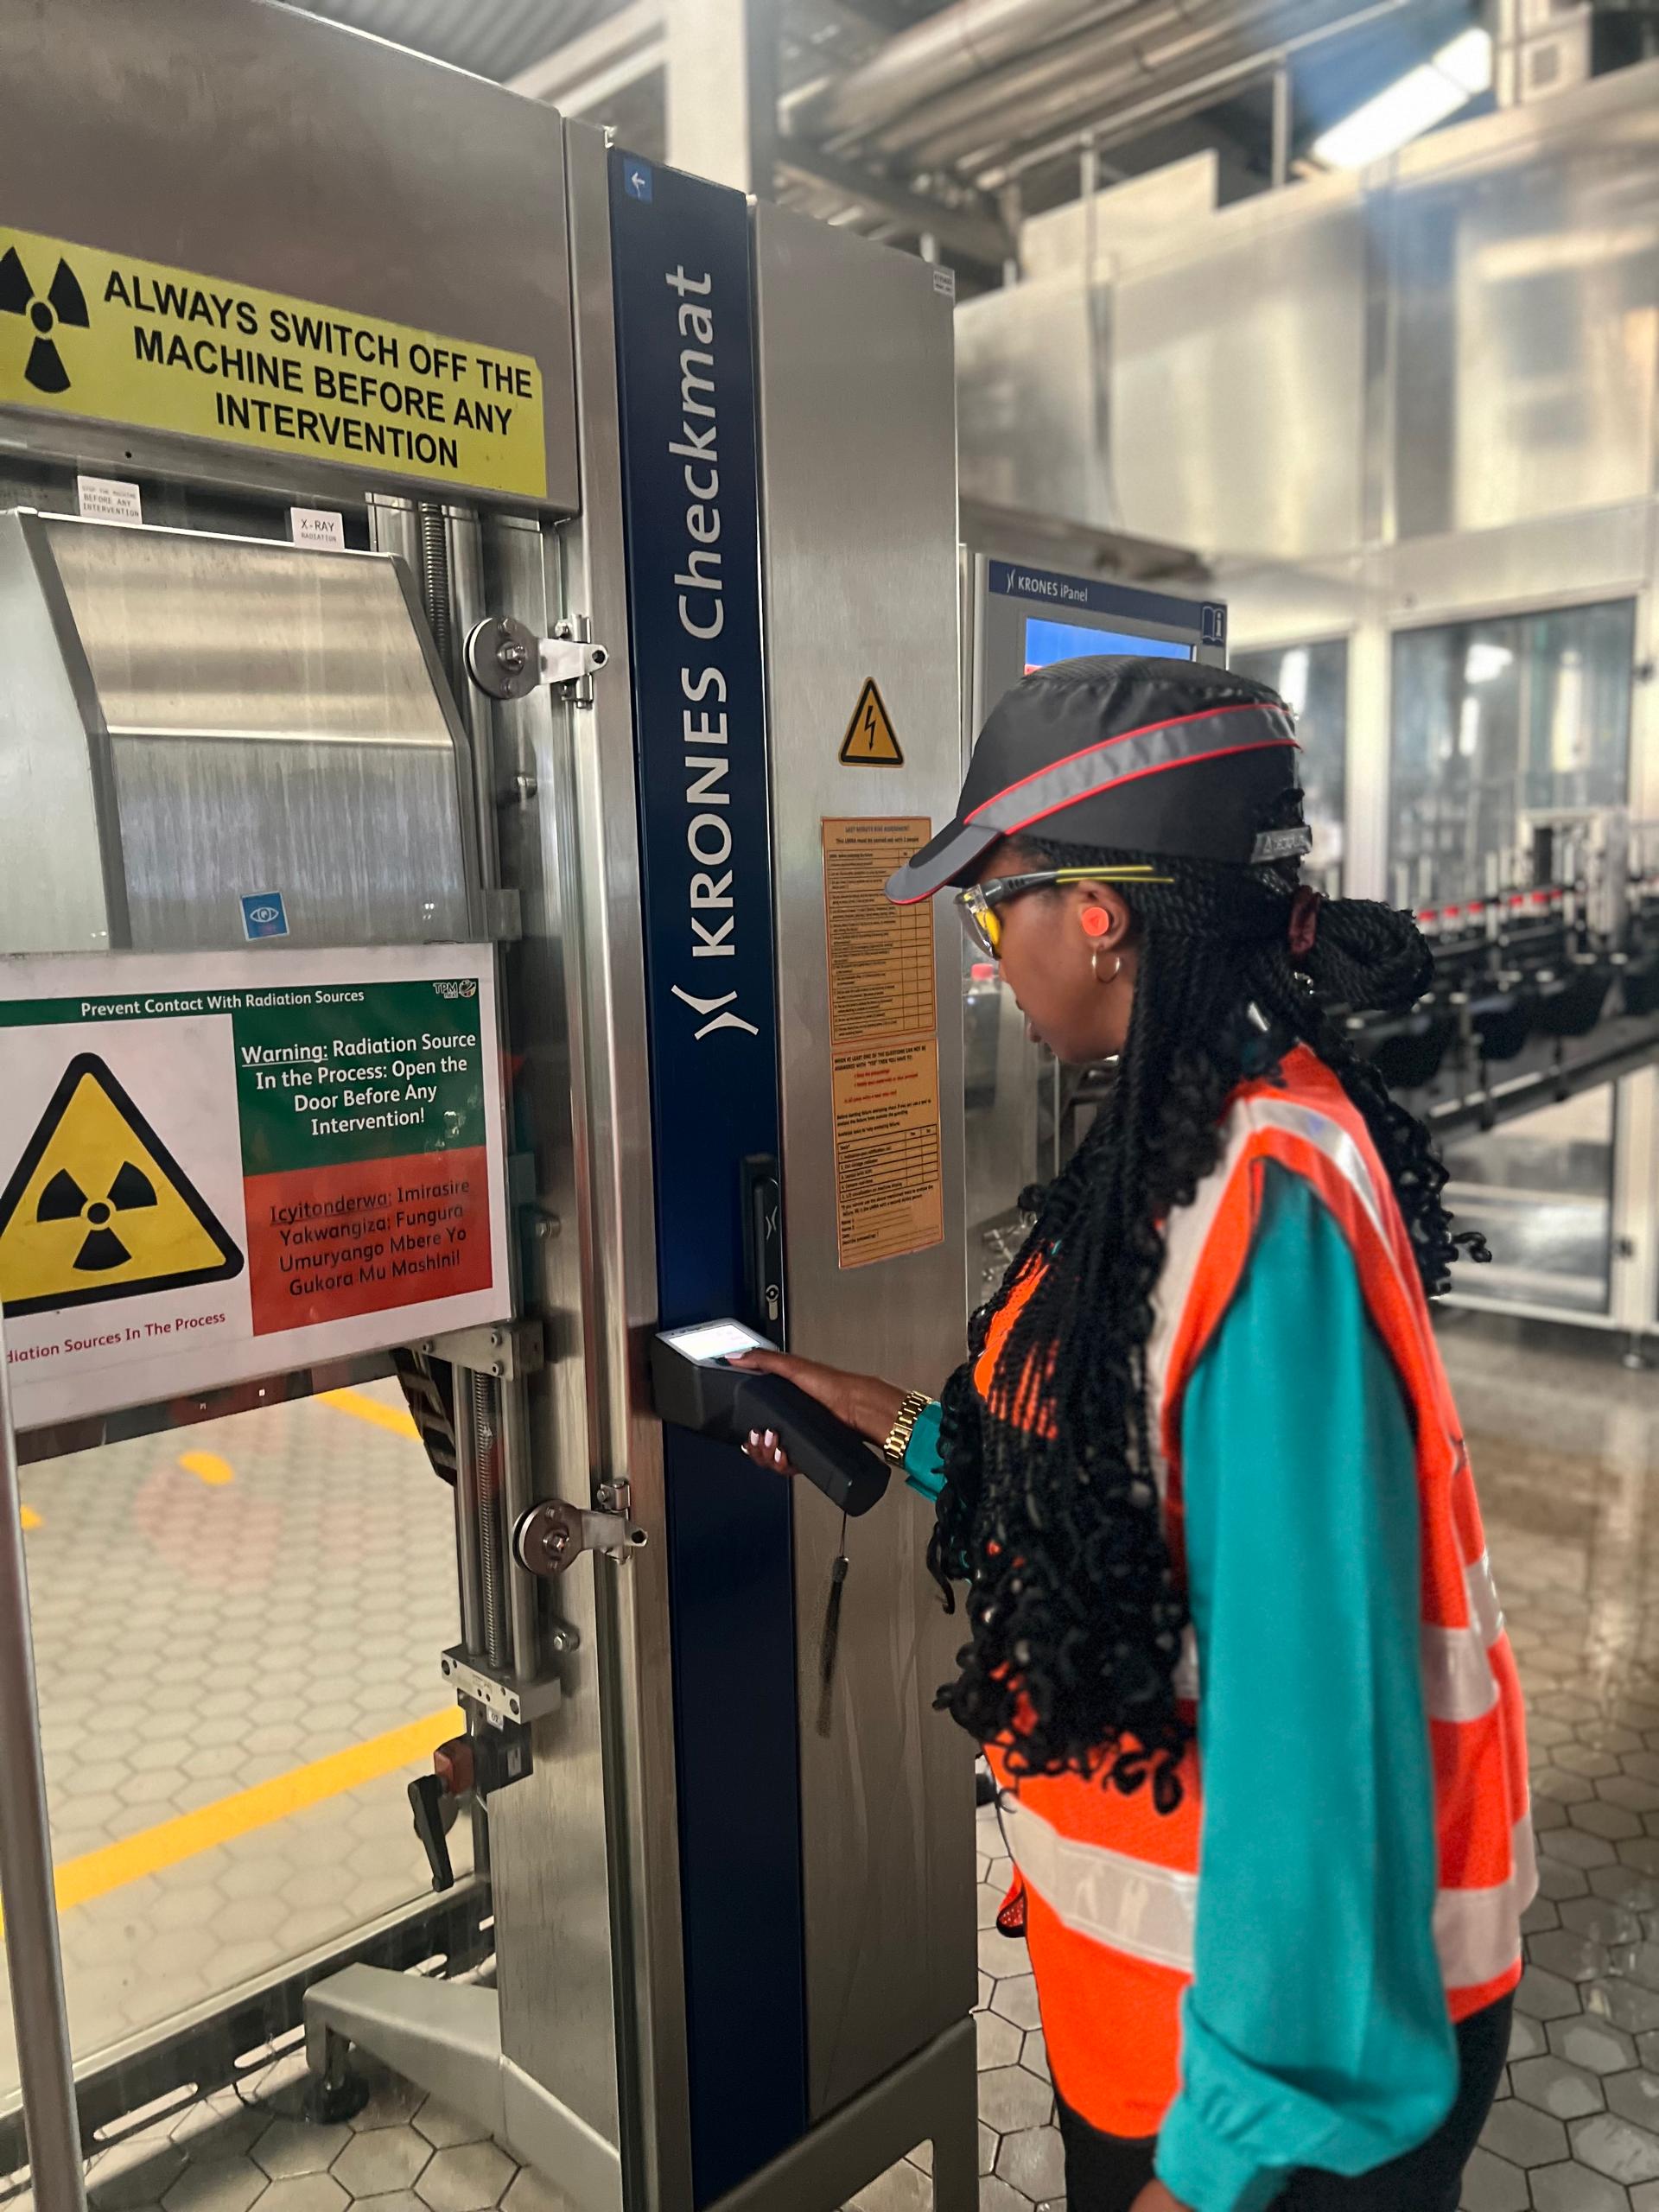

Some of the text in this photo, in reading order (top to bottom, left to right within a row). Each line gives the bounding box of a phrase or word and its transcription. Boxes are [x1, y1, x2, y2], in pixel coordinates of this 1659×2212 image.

[104, 270, 532, 399] ALWAYS SWITCH OFF THE
[134, 325, 512, 435] MACHINE BEFORE ANY
[216, 392, 458, 468] INTERVENTION
[83, 503, 139, 517] INTERVENTION
[301, 518, 334, 531] X-RAY
[1018, 575, 1088, 602] KRONES iPanel
[664, 264, 735, 957] KRONES Checkmat
[80, 990, 365, 1017] Prevent Contact With Radiation Sources
[433, 982, 458, 994] TPM
[241, 1033, 476, 1065] Warning: Radiation Source
[256, 1056, 467, 1090] In the Process: Open the
[294, 1084, 437, 1112] Door Before Any
[311, 1107, 425, 1136] Intervention!
[397, 1180, 470, 1204] Imirasire
[279, 1204, 463, 1247] Yakwangiza: Fungura
[279, 1226, 467, 1273] Umuryango Mbere Yo
[289, 1272, 353, 1296] Gukora
[359, 1265, 386, 1283] Mu
[64, 1332, 122, 1353] Sources
[125, 1327, 141, 1341] In
[144, 1322, 172, 1337] The
[175, 1313, 226, 1332] Process
